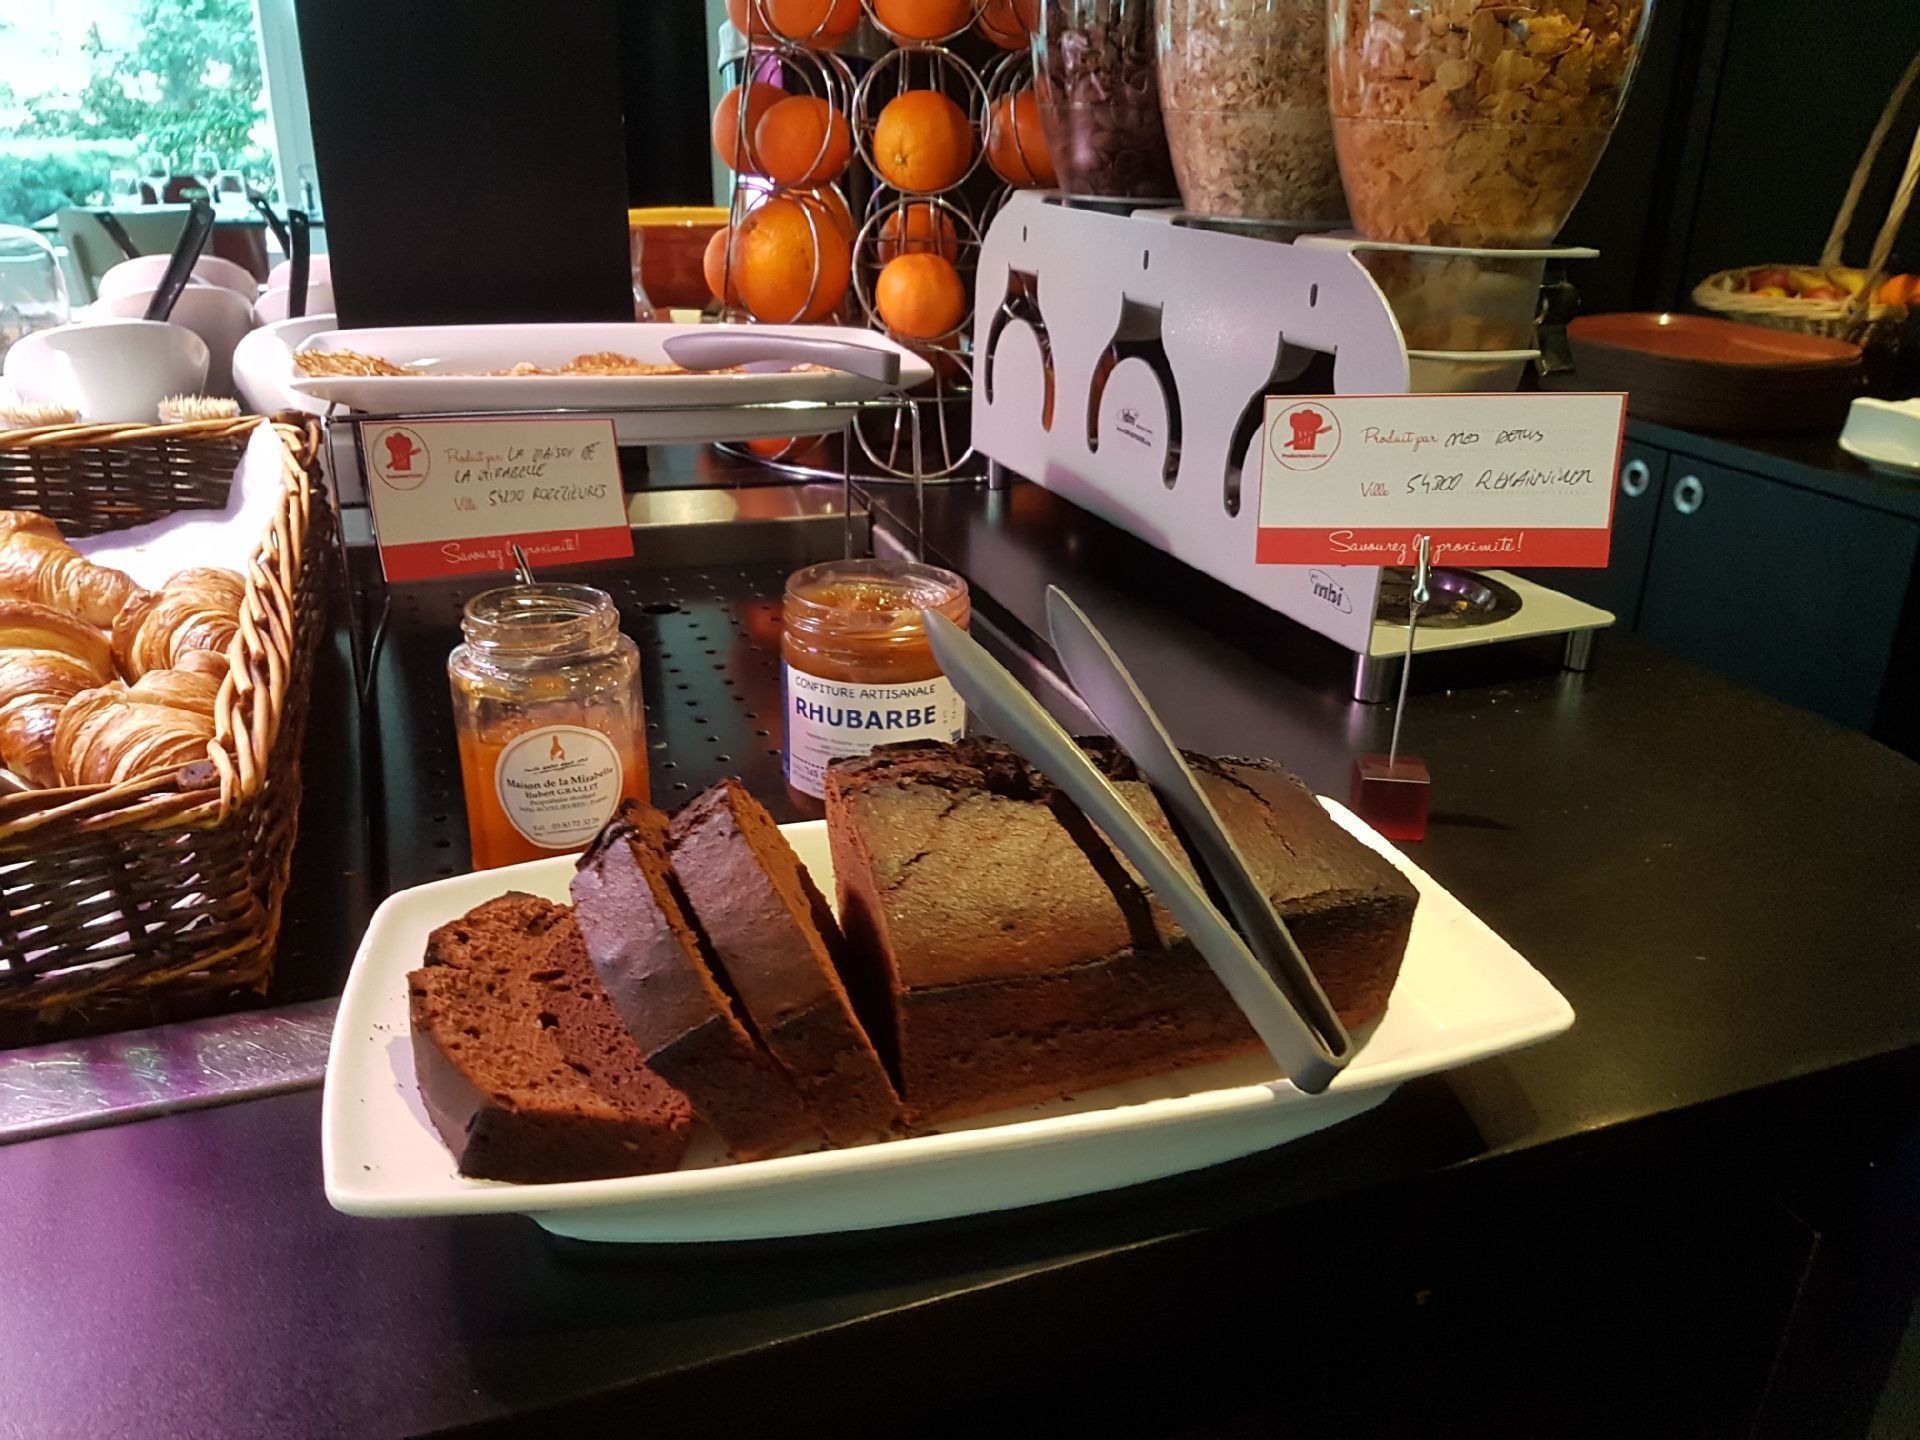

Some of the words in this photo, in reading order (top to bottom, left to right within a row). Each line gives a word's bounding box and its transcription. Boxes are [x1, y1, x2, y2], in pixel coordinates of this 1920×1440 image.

[1360, 426, 1413, 443] Produit
[1412, 434, 1438, 452] par
[454, 468, 471, 483] LA
[1360, 480, 1389, 497] Ville
[440, 542, 504, 570] Savourez
[1328, 530, 1406, 564] Savourez
[795, 675, 854, 699] CONFITURE
[859, 683, 937, 700] ARTISANALE
[795, 696, 937, 730] RHUBARBE
[506, 777, 541, 790] Maison
[543, 779, 556, 788] de
[558, 777, 568, 786] la
[570, 767, 613, 784] Mirabelle
[525, 788, 555, 799] Hubert
